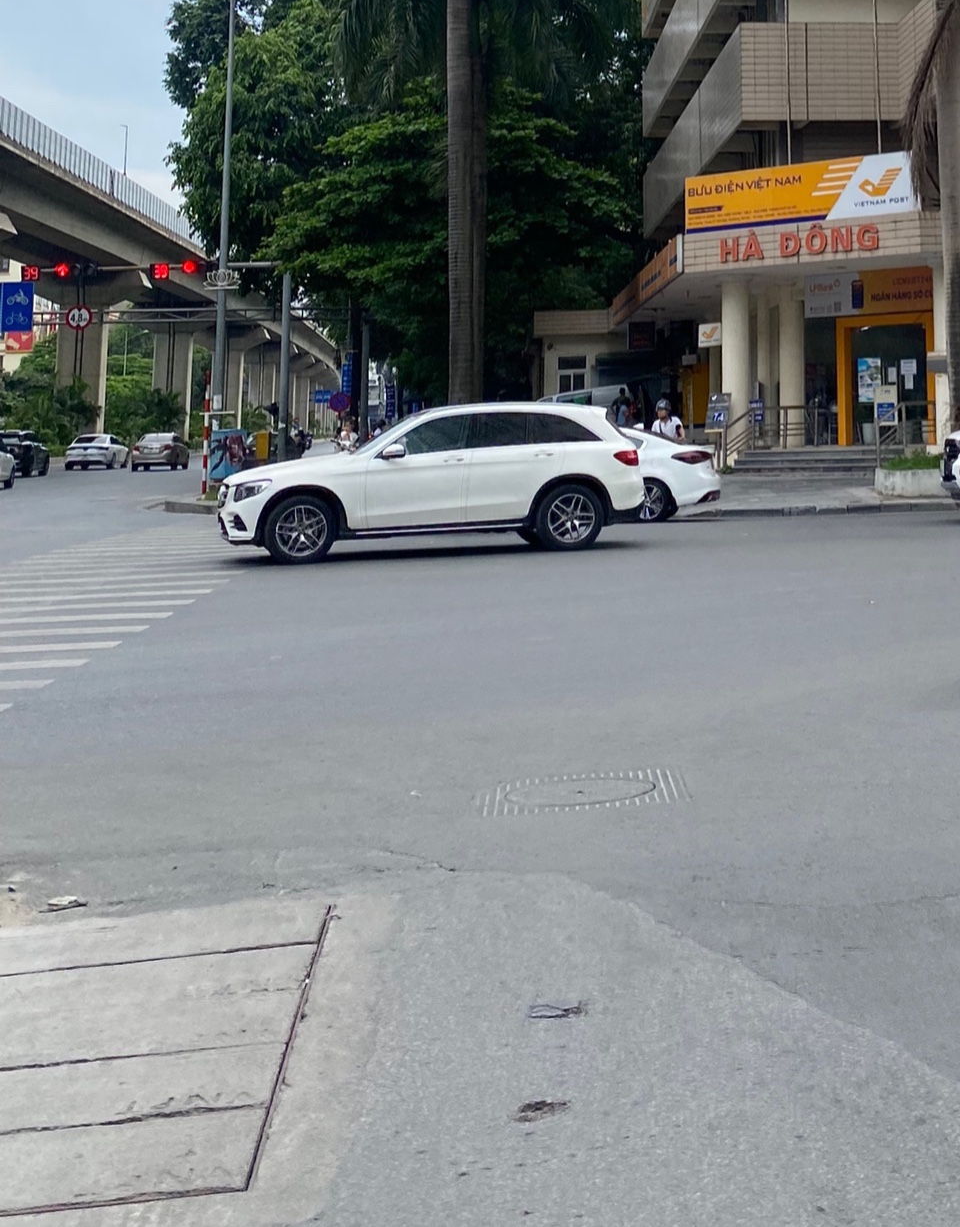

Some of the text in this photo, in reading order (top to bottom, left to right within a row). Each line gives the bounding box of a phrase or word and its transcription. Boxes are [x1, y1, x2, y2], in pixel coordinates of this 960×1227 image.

[688, 175, 802, 197] BƯU ĐIỆN VIỆT NAM
[854, 196, 909, 208] VIETNAM POST
[719, 222, 879, 263] HÀ ĐÔNG
[24, 267, 38, 280] 39
